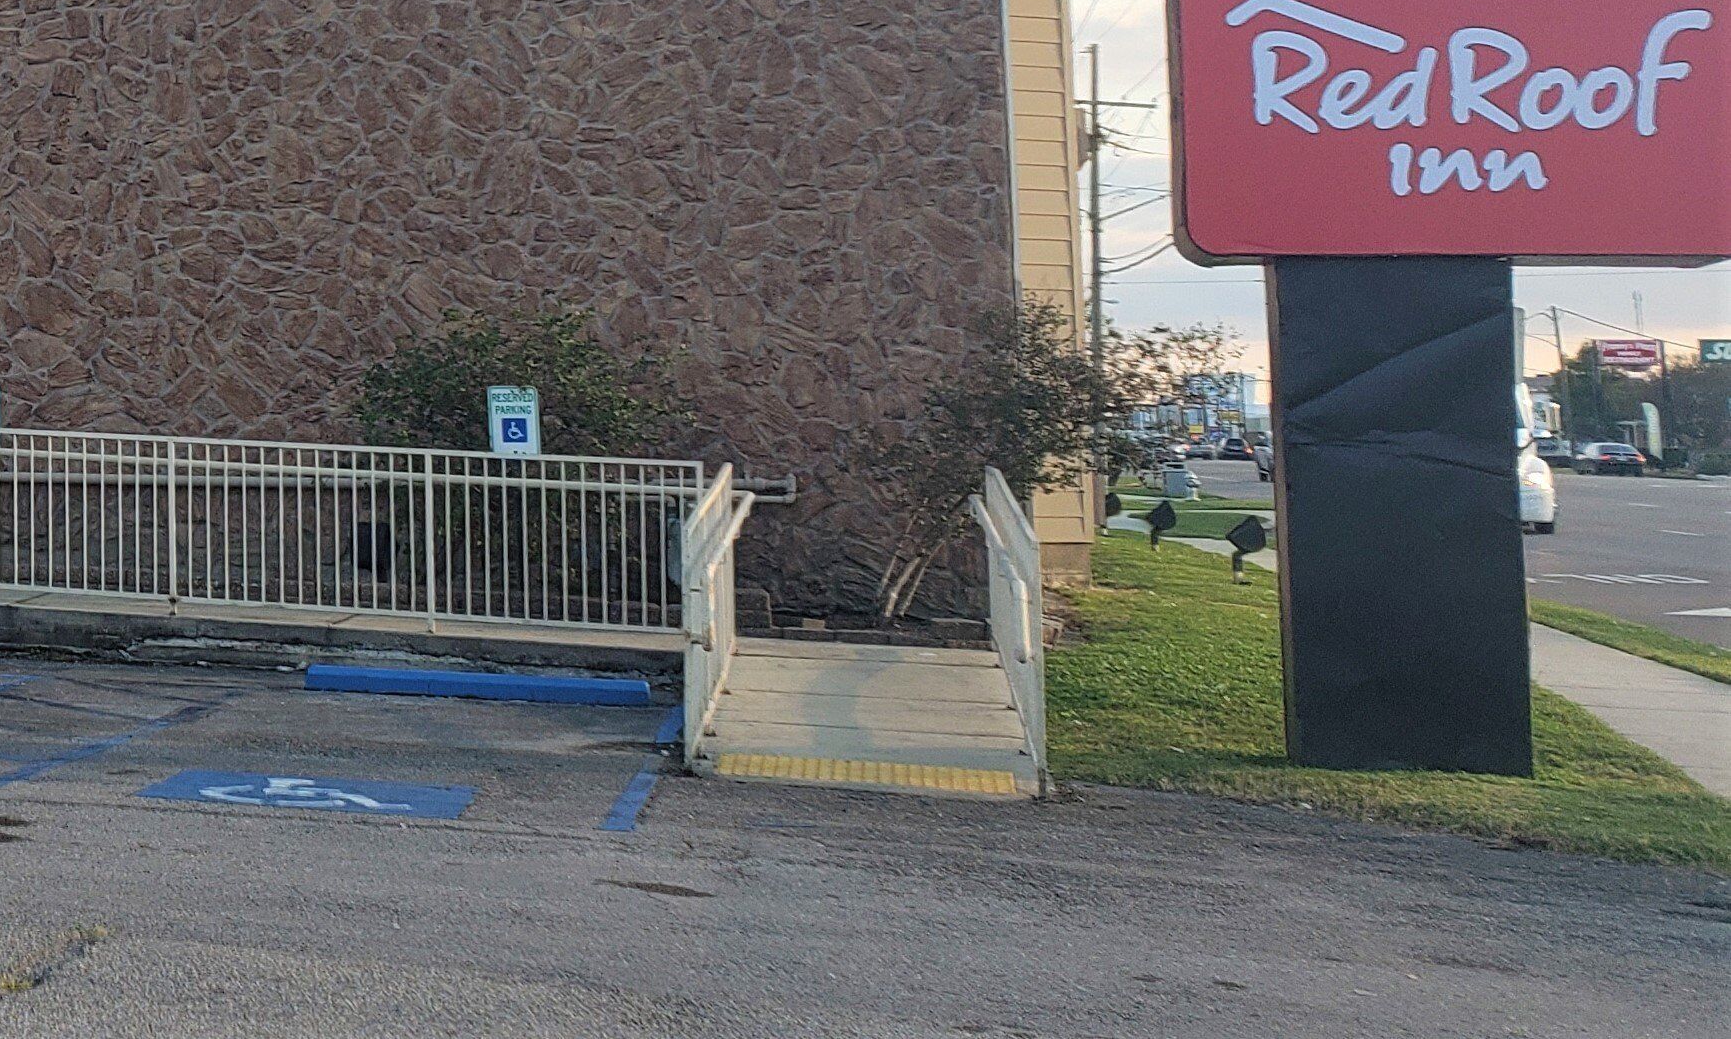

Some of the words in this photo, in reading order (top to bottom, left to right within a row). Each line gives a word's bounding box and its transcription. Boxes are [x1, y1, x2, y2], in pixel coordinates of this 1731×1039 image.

[1251, 27, 1439, 134] Red
[1447, 9, 1713, 136] Roof
[491, 392, 533, 403] RESERVED
[494, 405, 532, 415] PARKING
